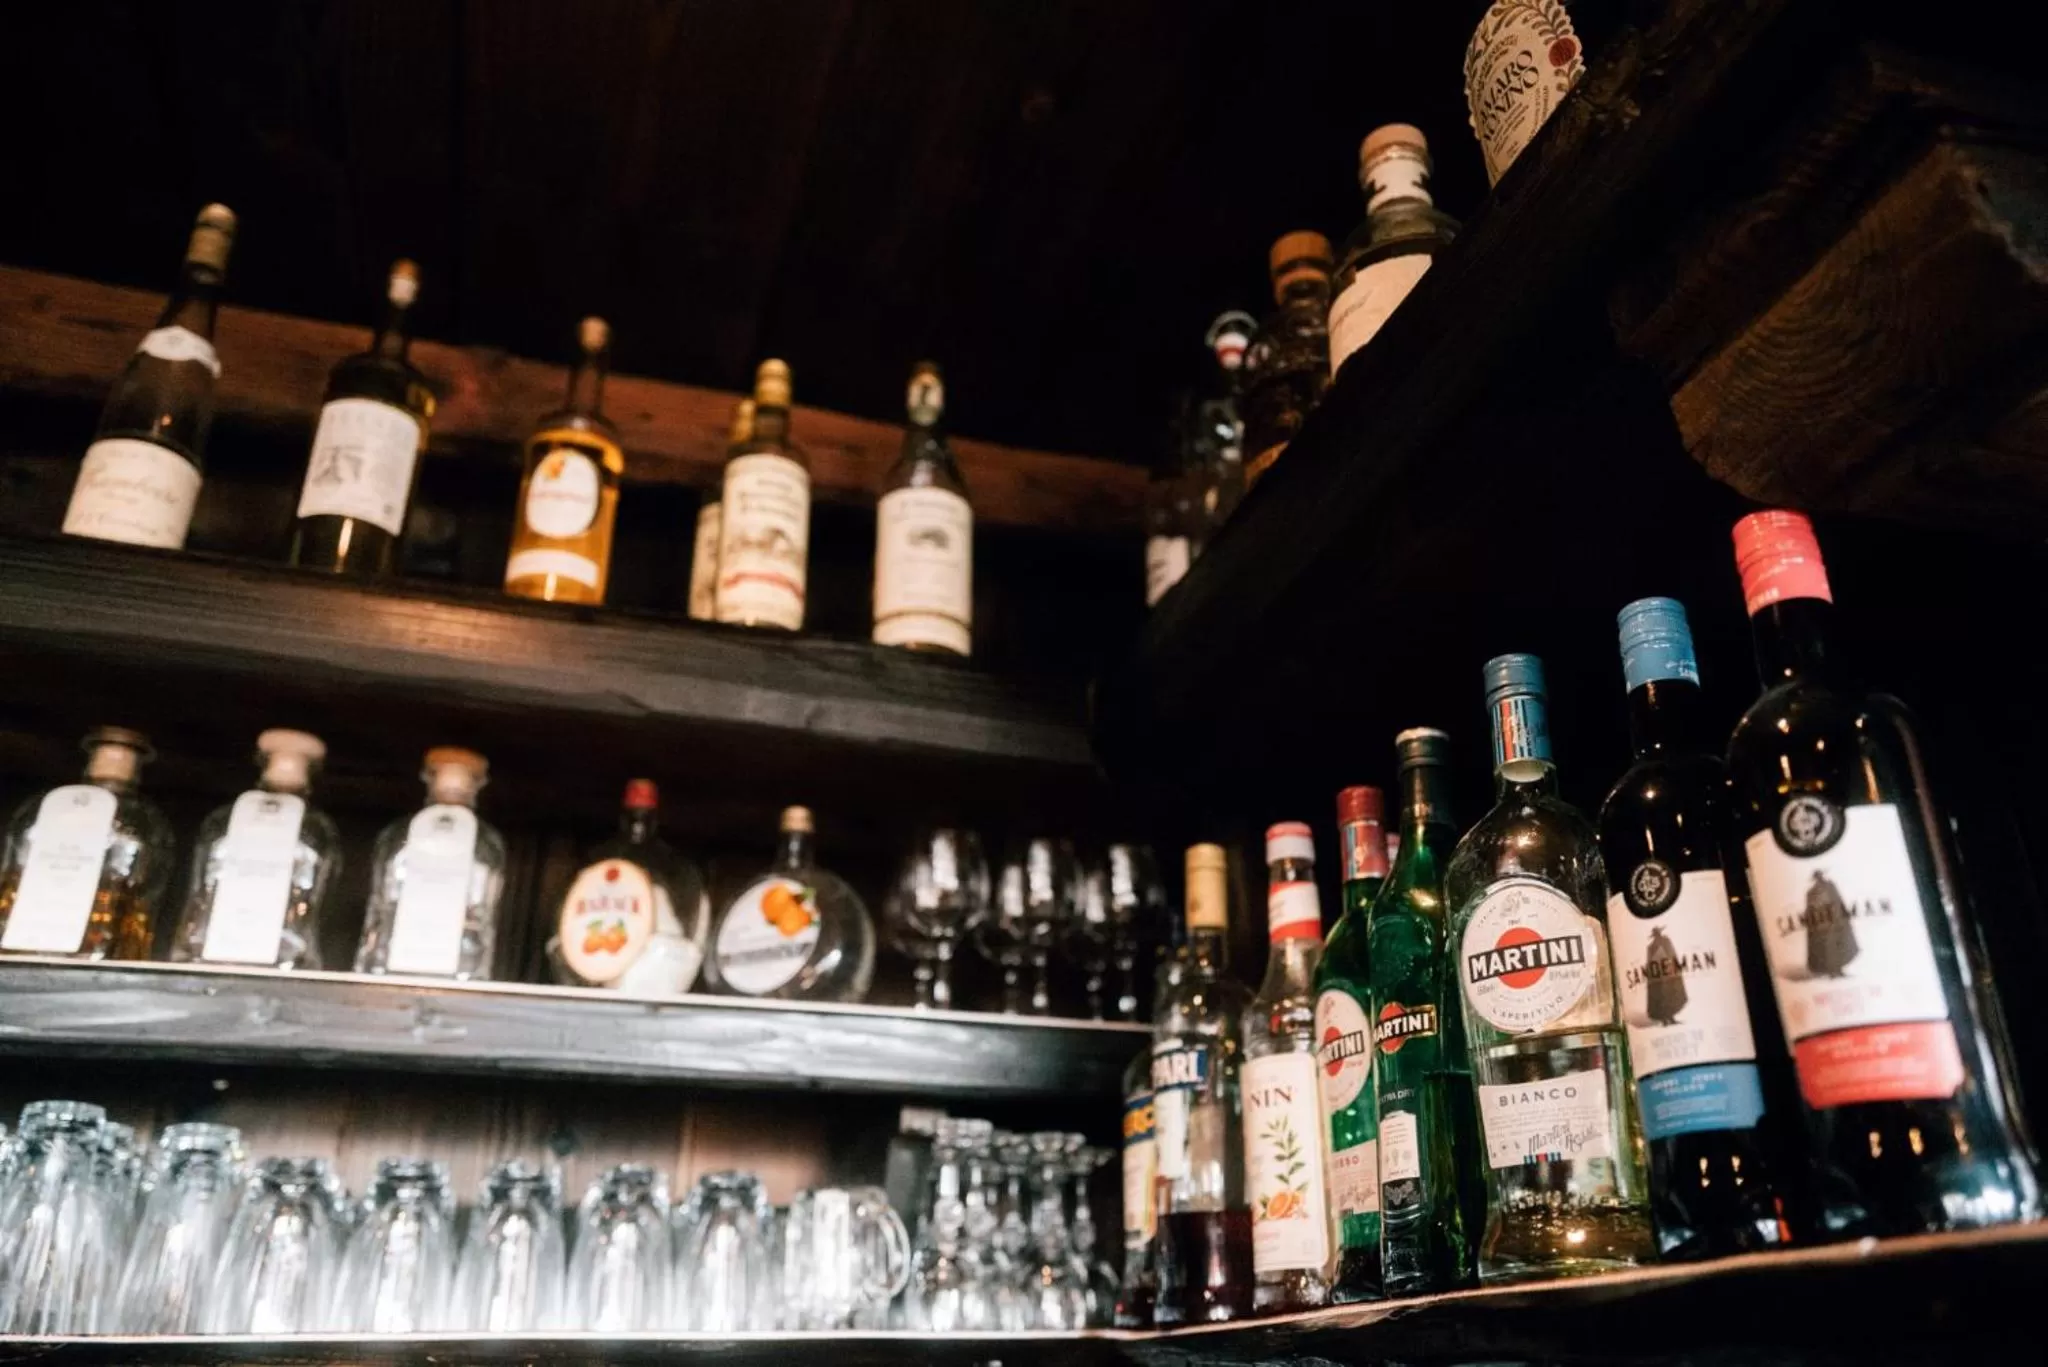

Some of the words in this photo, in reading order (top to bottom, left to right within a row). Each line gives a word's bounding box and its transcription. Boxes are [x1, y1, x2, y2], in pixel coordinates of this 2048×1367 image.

[1471, 938, 1581, 982] MARTINI
[1626, 949, 1717, 989] SANDEMAN
[1499, 1087, 1577, 1107] BIANCO
